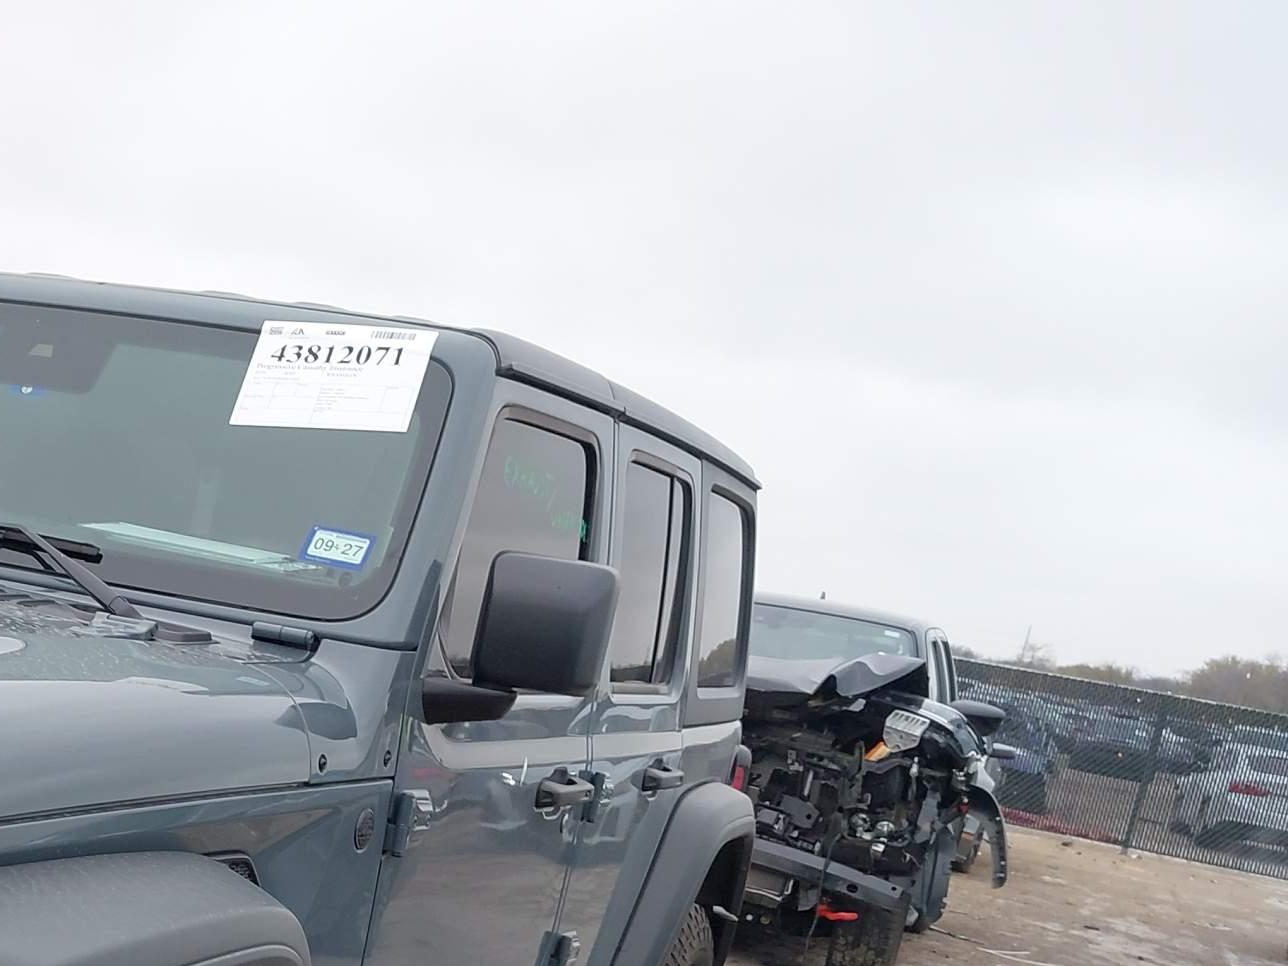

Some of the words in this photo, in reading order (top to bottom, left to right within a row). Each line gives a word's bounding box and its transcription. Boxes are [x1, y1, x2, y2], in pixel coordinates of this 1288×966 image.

[270, 344, 404, 367] 43812071
[313, 537, 335, 552] 09
[340, 543, 364, 557] 27
